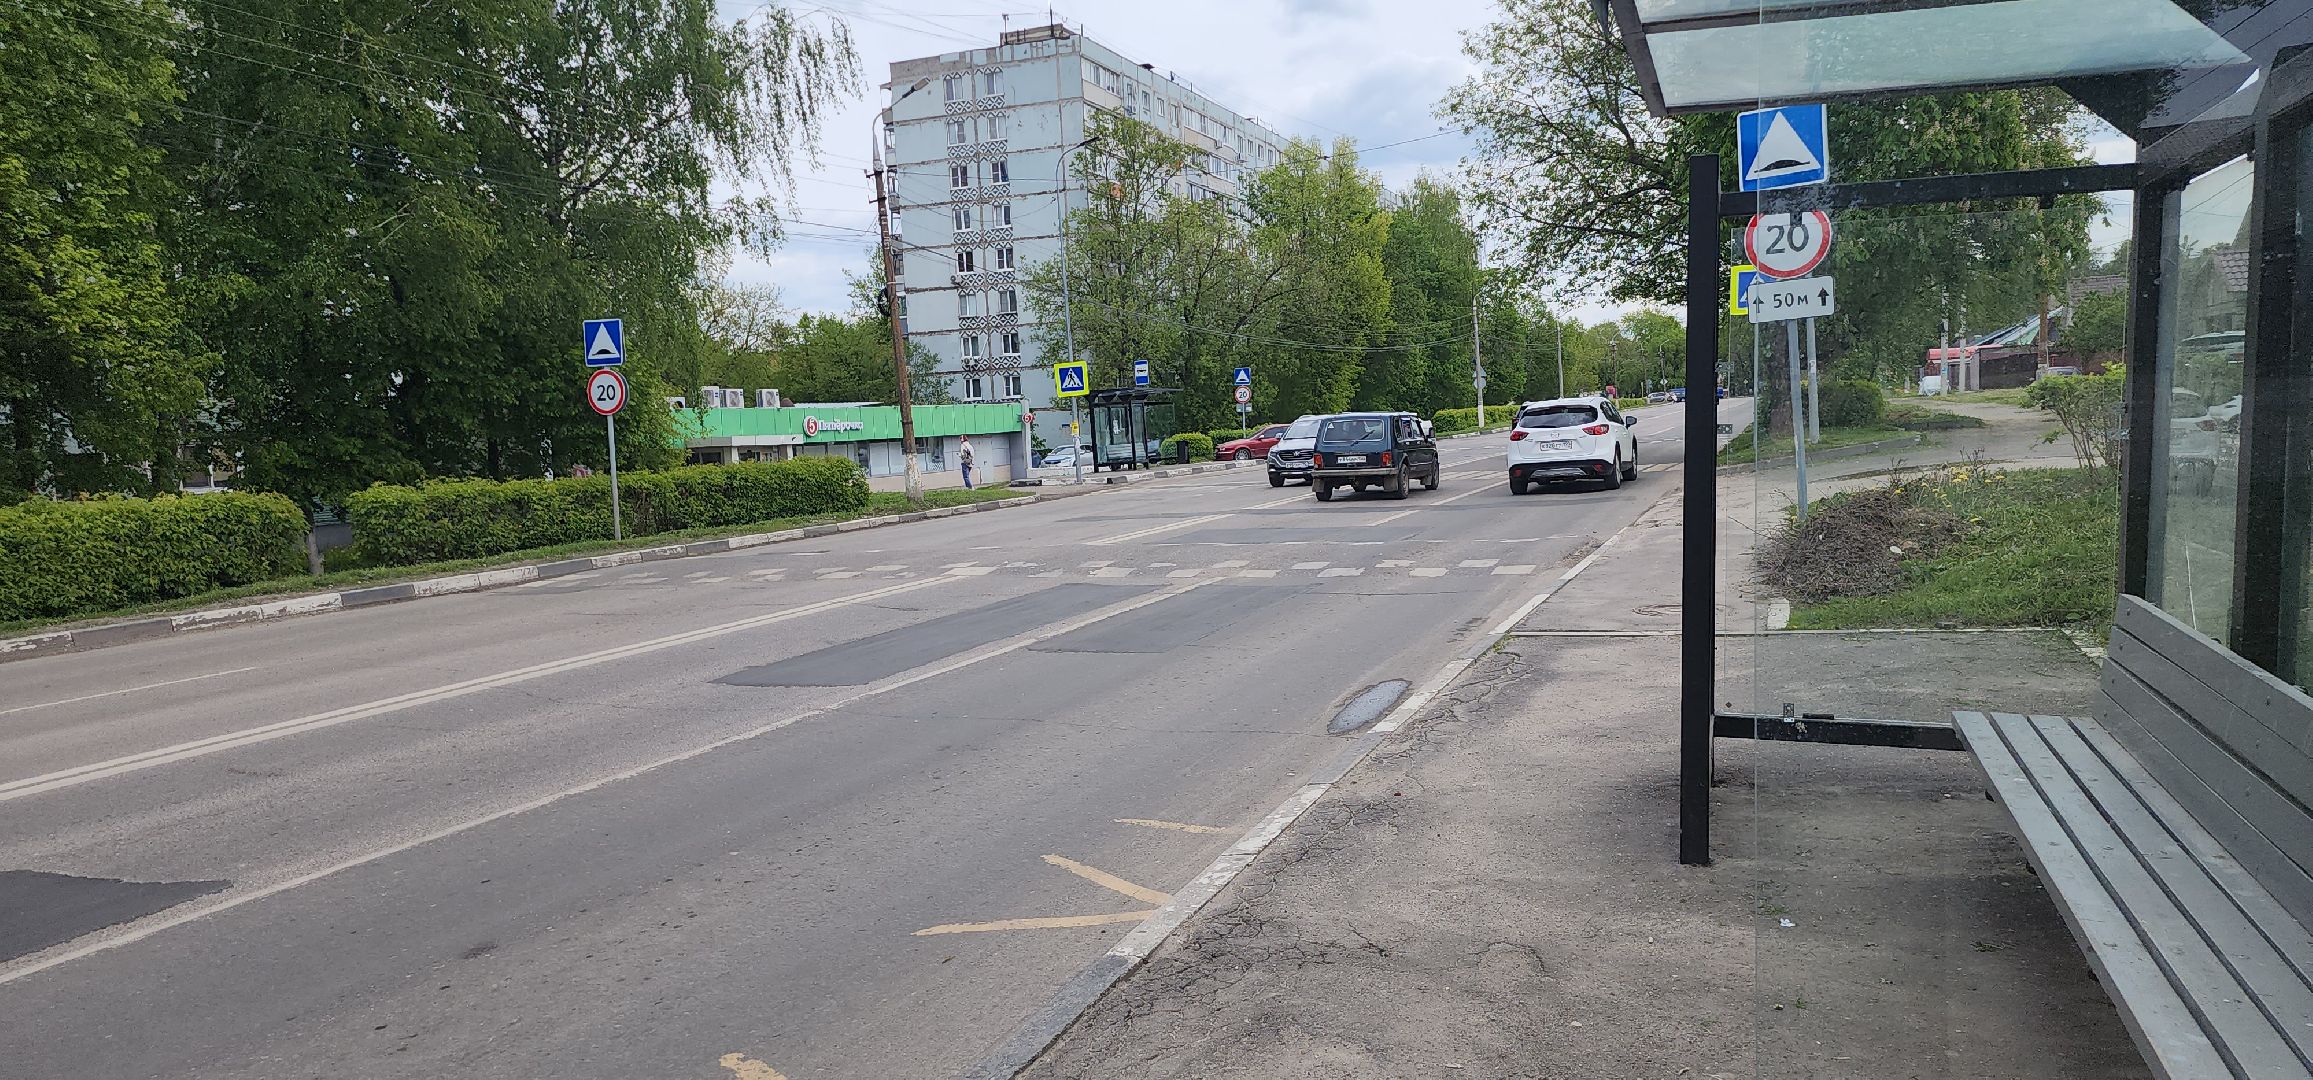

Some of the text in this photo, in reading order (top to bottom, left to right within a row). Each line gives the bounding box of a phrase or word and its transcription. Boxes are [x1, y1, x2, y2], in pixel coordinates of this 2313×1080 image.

[1766, 224, 1809, 254] 20
[596, 384, 616, 401] 20
[1238, 390, 1248, 399] 20
